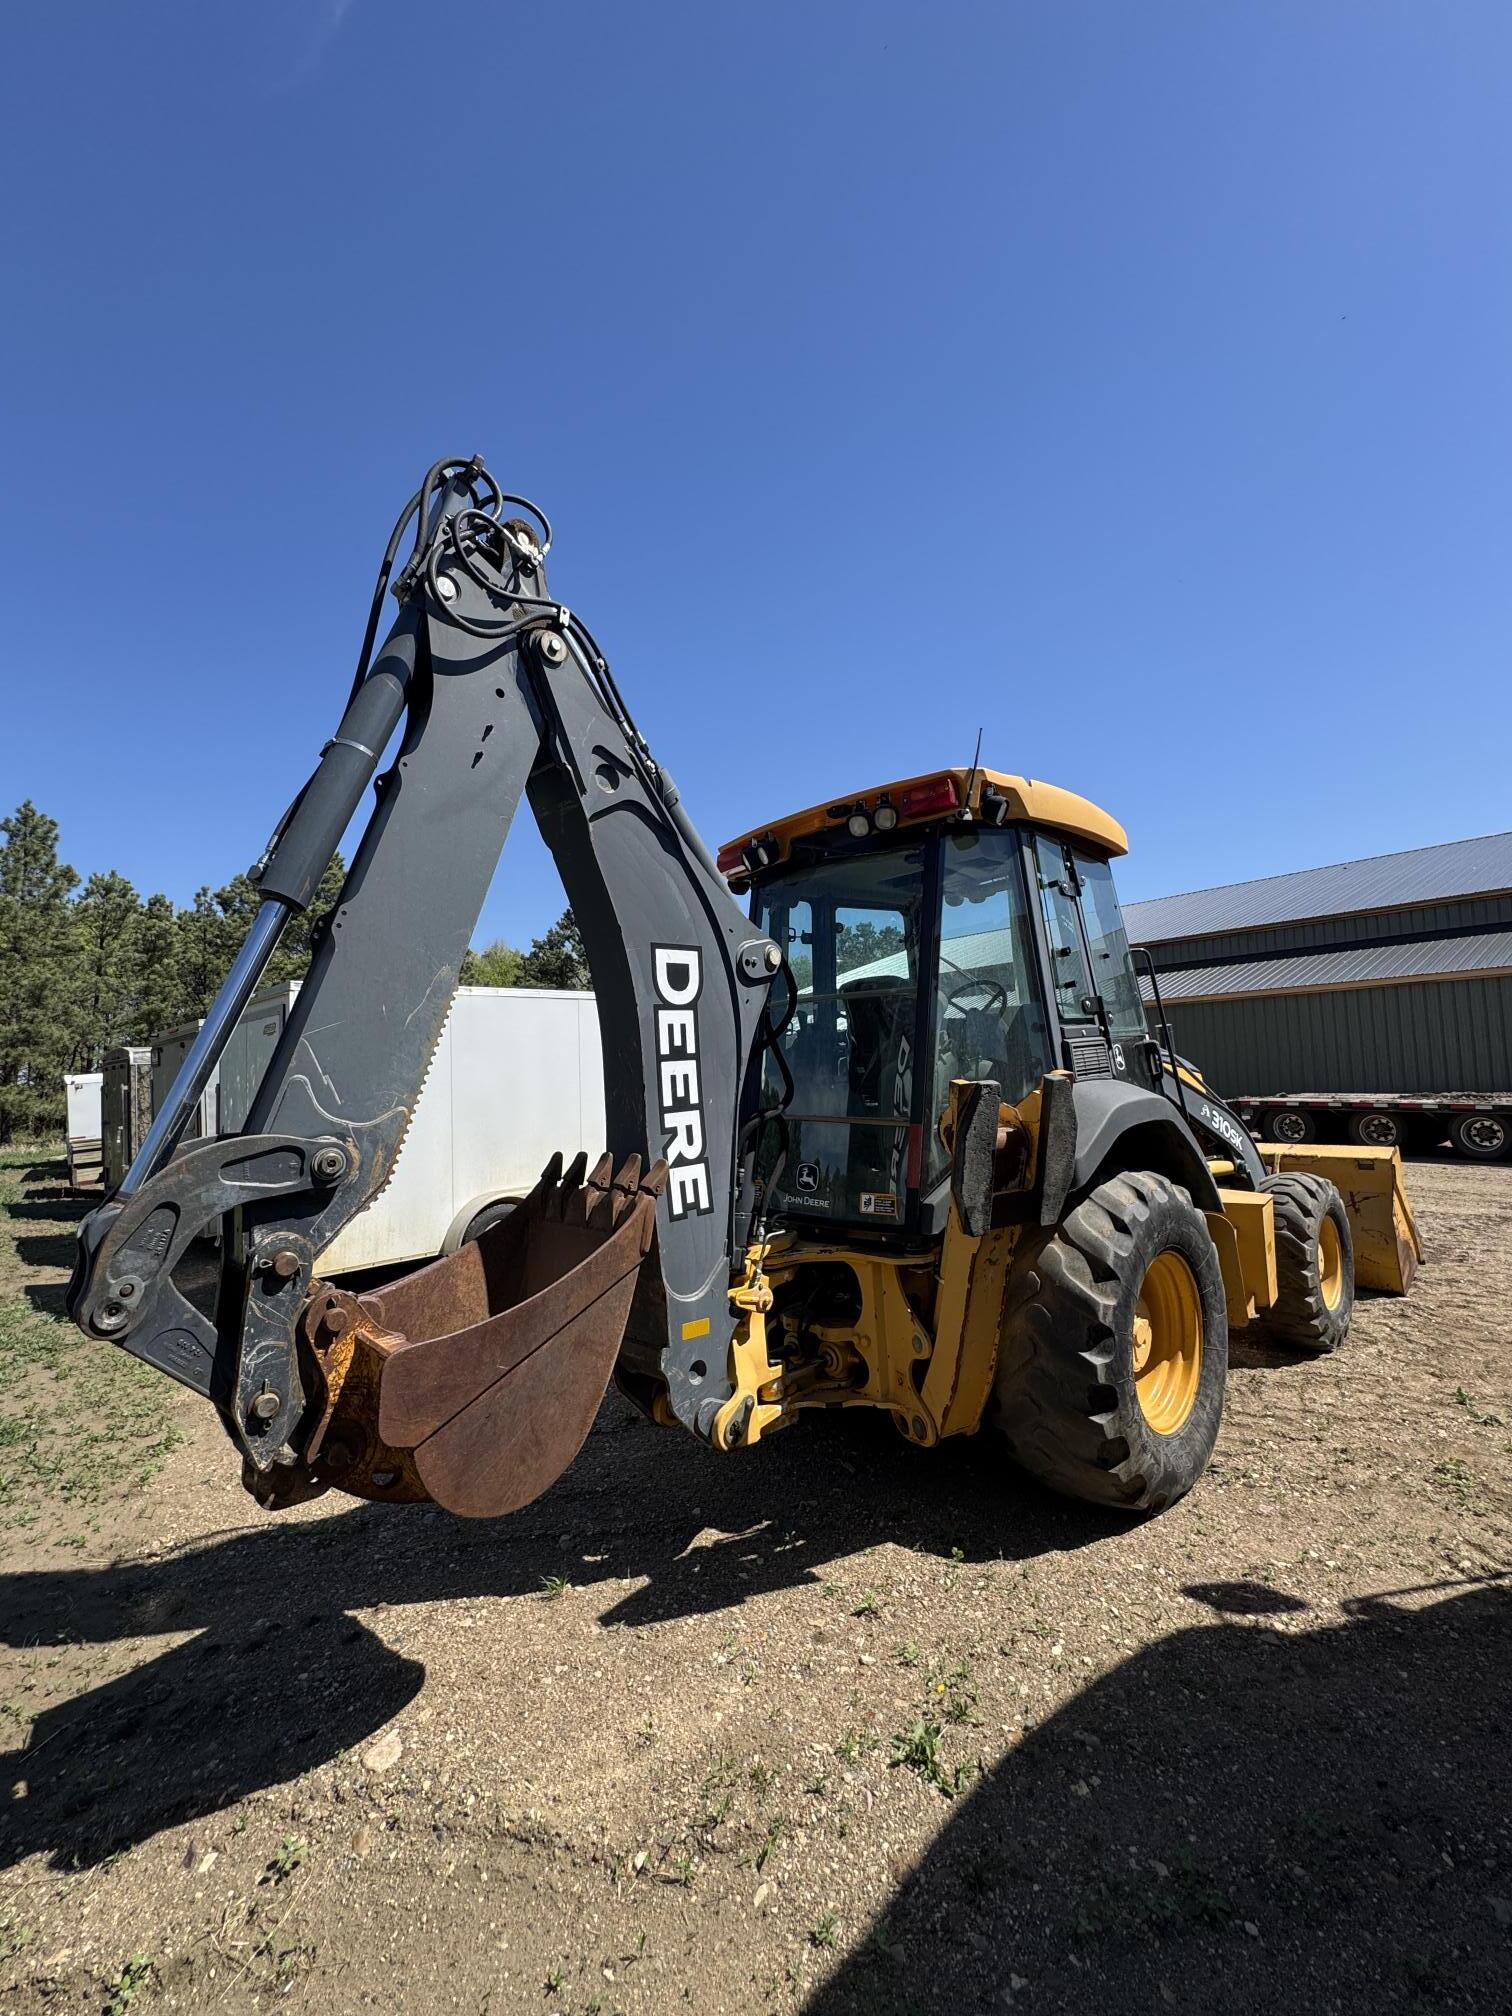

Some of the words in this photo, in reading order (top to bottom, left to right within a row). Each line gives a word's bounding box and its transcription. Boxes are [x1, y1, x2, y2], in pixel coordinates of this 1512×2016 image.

[655, 948, 710, 1215] DEERE
[1211, 1110, 1243, 1151] 310SK
[783, 1193, 802, 1204] JOHN
[803, 1196, 830, 1208] DEERE
